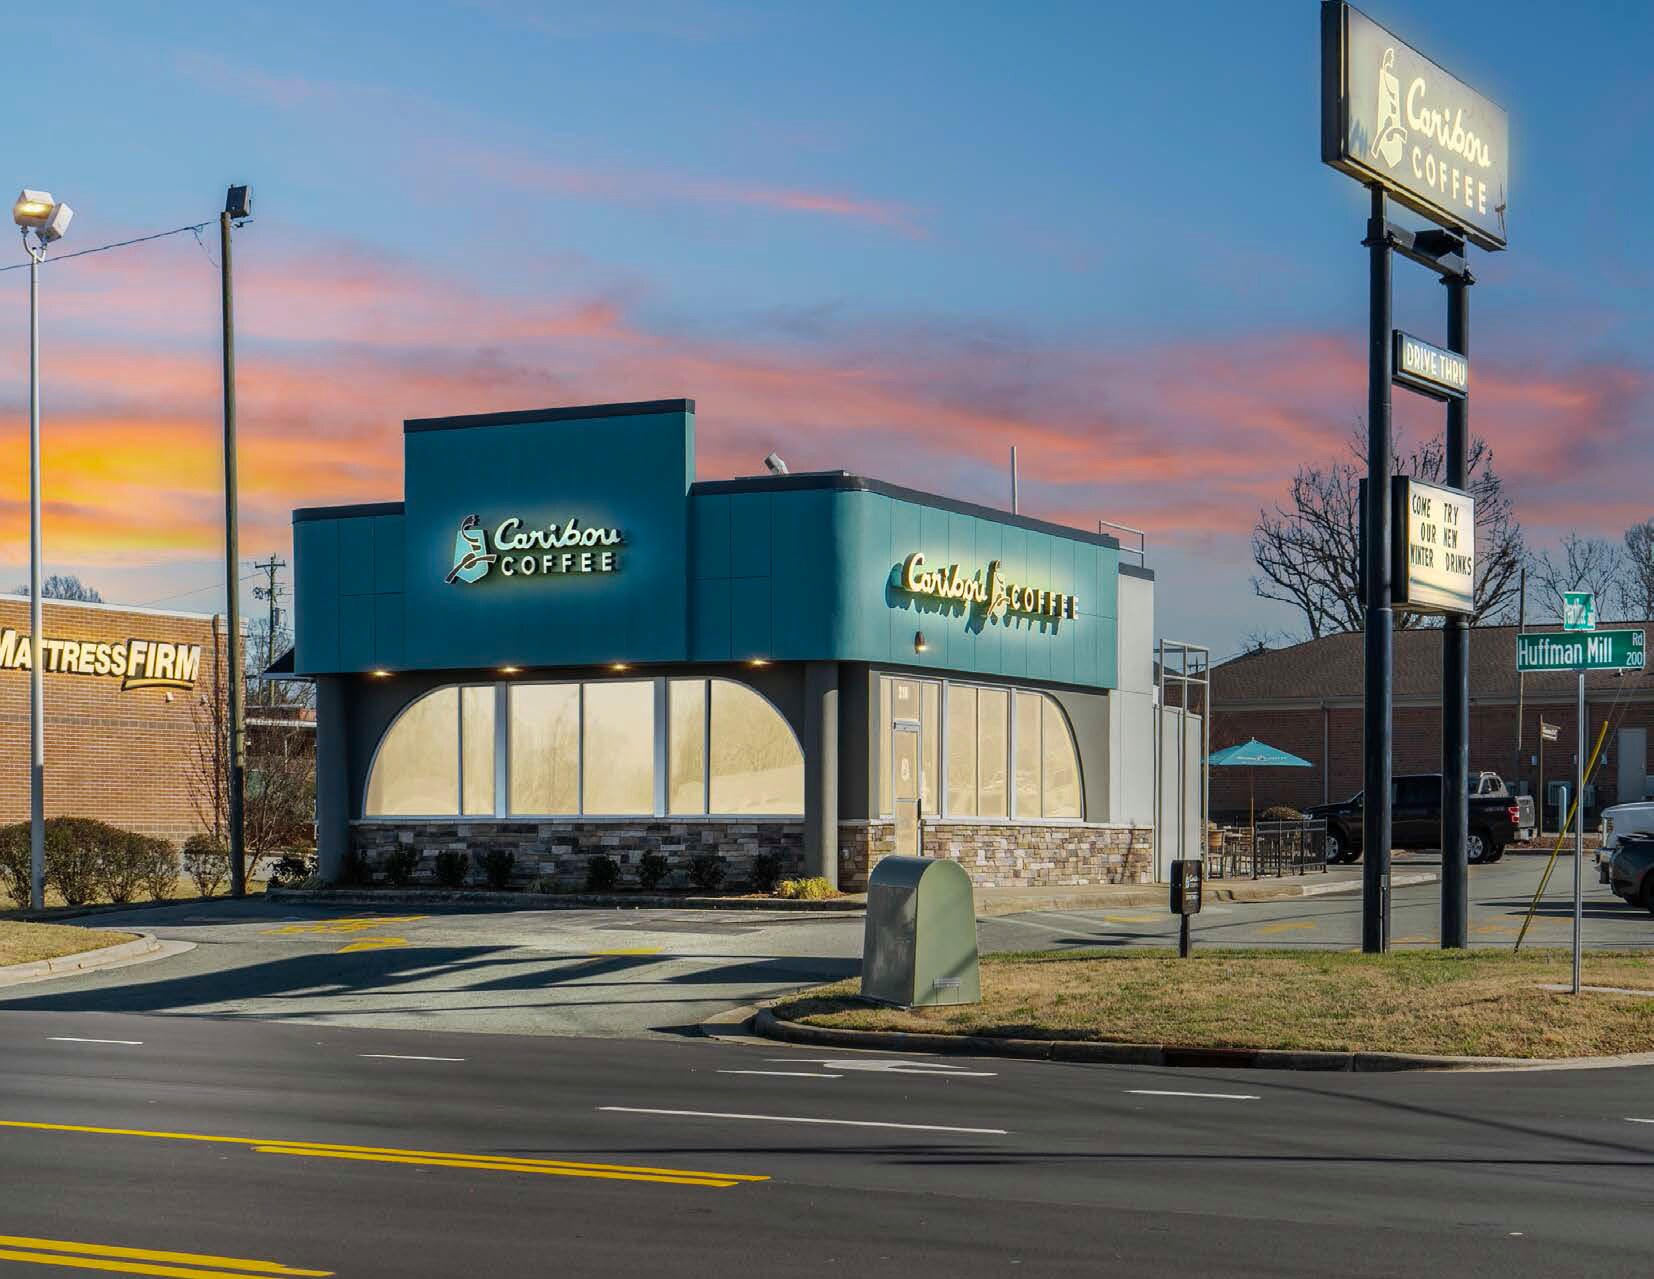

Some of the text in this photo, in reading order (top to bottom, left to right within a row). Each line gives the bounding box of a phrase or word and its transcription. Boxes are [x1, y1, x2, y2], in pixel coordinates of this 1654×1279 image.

[1407, 77, 1491, 168] Caribou
[1412, 146, 1487, 215] COFFEE
[1406, 342, 1465, 386] DRIVE THRU
[1412, 494, 1458, 526] COME TRY
[494, 517, 621, 550] Caribou
[1420, 522, 1458, 549] OUR NEW
[501, 552, 612, 576] COFFEE
[1410, 543, 1471, 576] WINTER DRINKS
[904, 552, 1079, 620] Caribou COFFEE
[1519, 636, 1612, 666] Huffman Mill
[1632, 632, 1643, 646] Rd
[1626, 651, 1643, 666] 200
